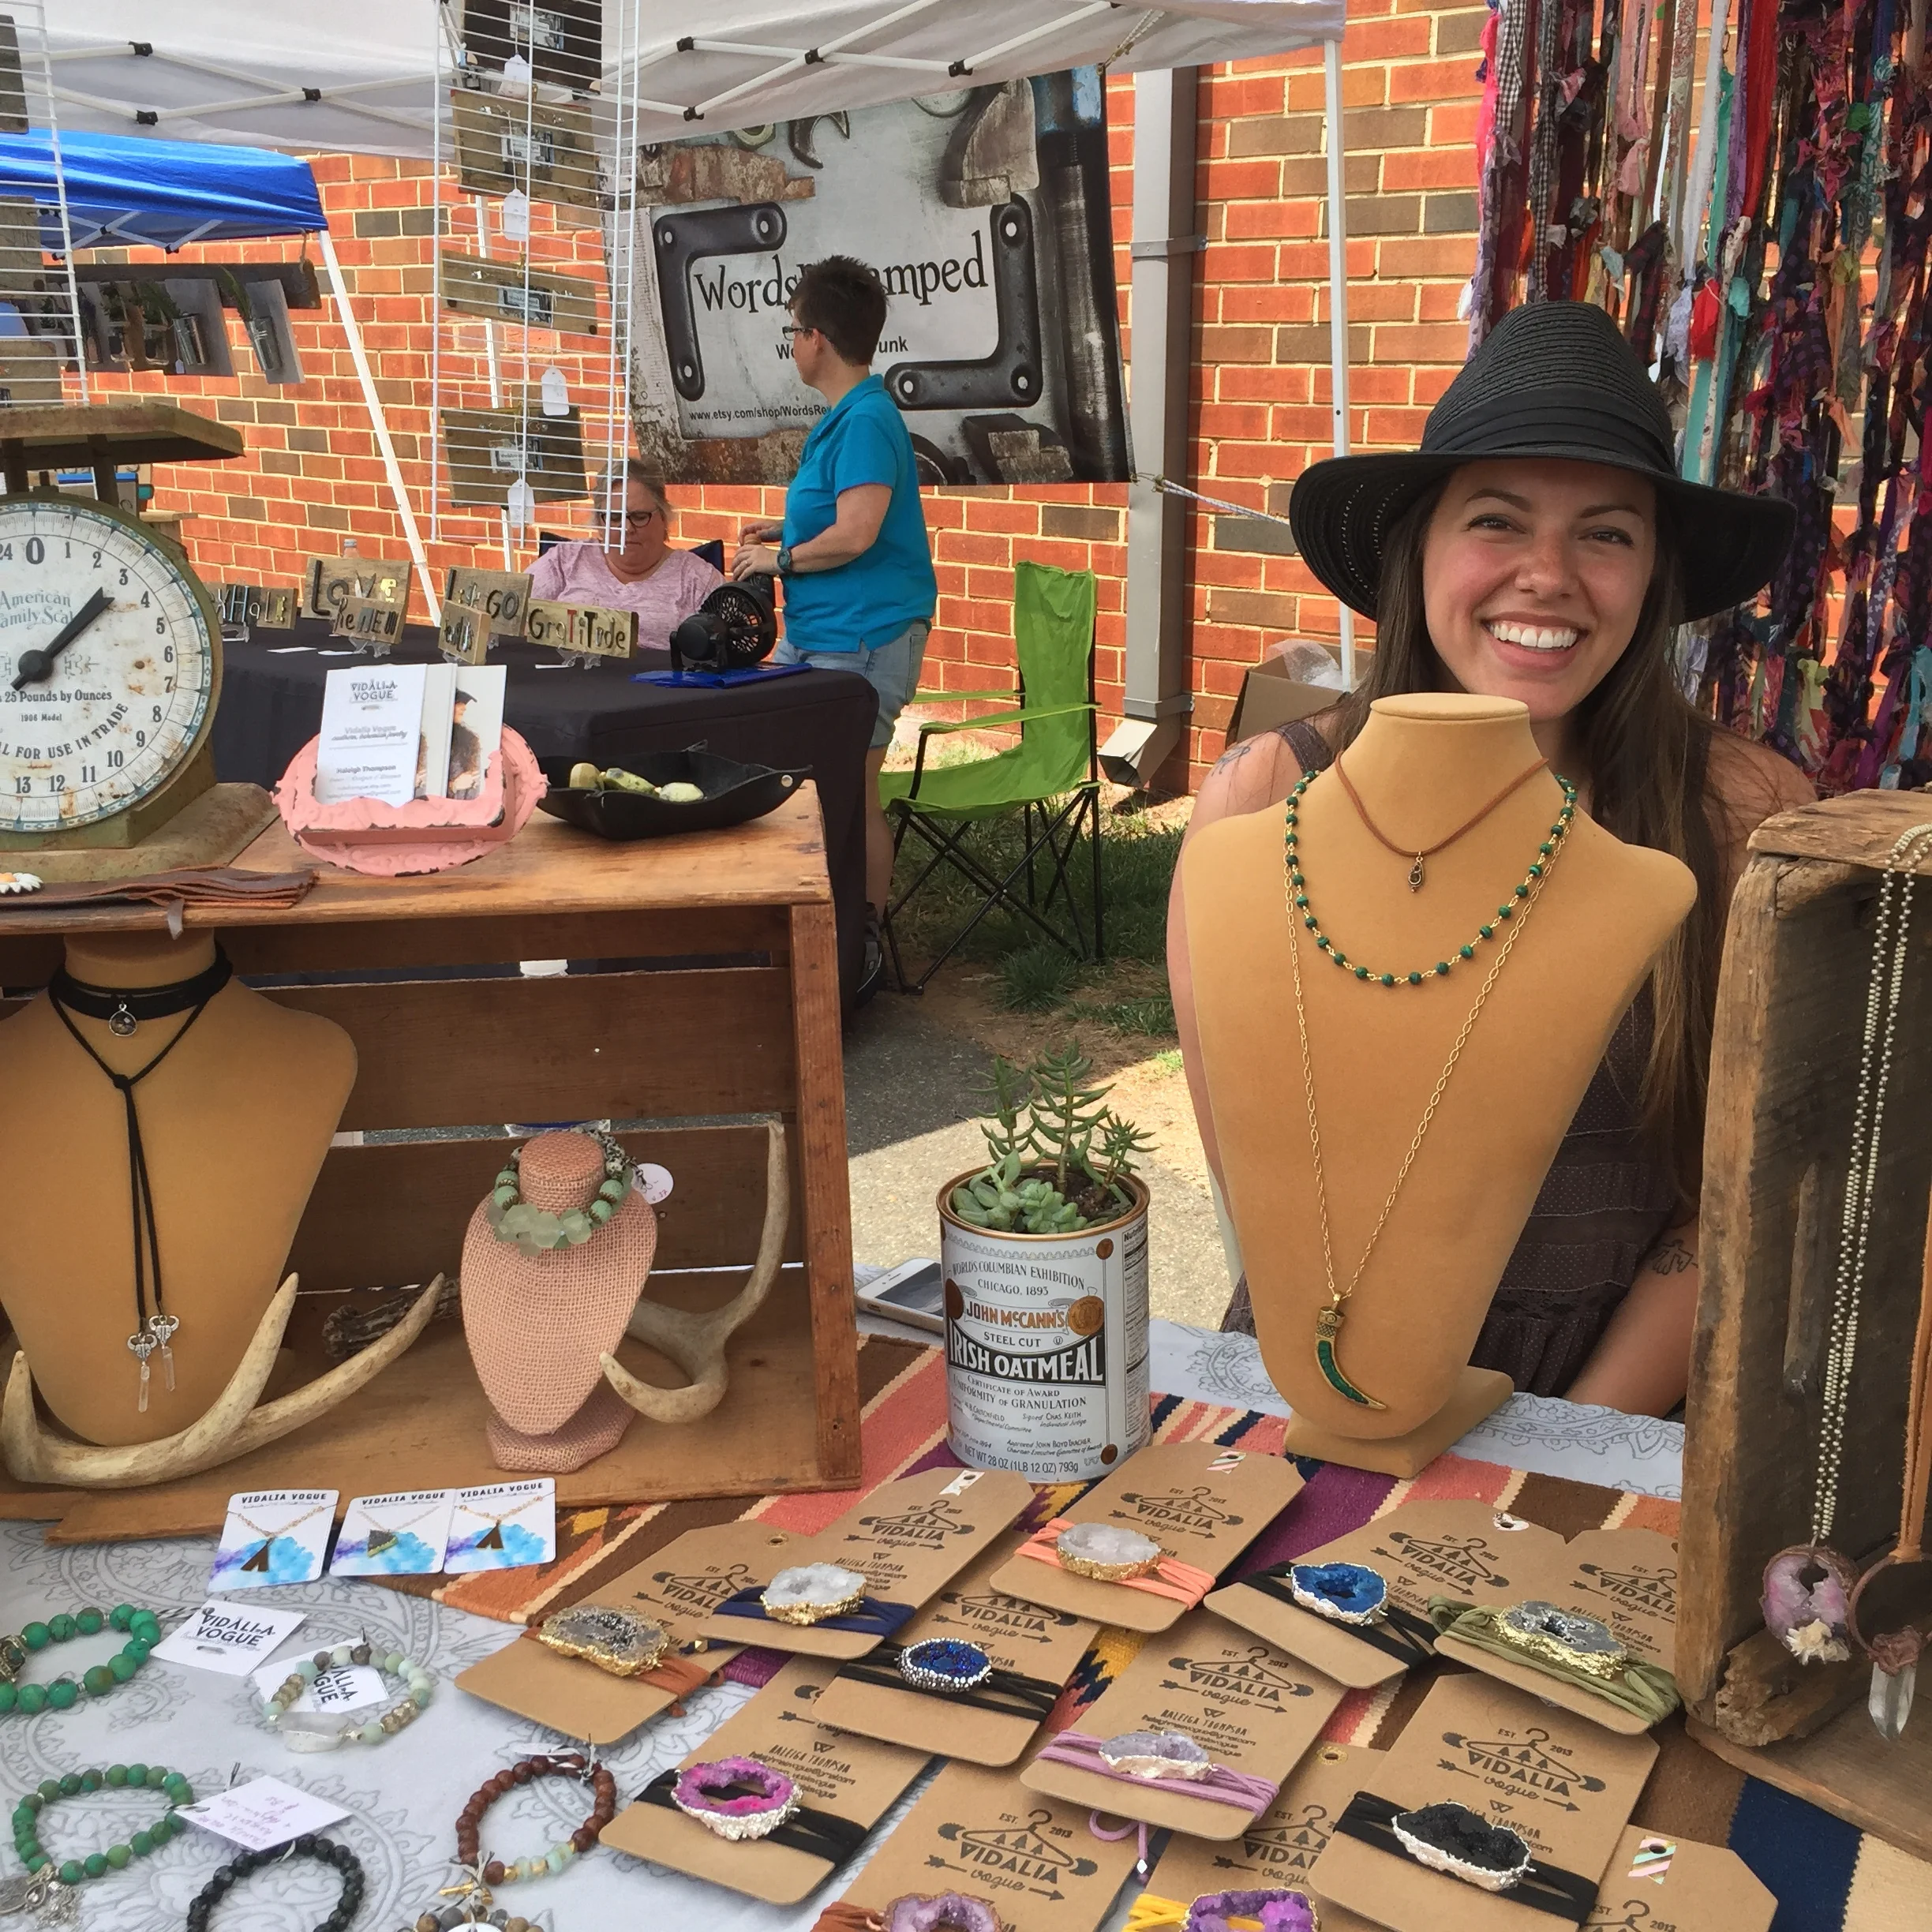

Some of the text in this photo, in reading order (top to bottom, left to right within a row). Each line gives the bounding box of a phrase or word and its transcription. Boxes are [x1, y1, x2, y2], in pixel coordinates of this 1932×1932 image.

[26, 537, 45, 564] 0
[66, 542, 71, 558] 1
[92, 552, 102, 568] 2
[119, 568, 128, 586] 3
[0, 590, 71, 610] American
[140, 591, 150, 608] 4
[0, 607, 39, 630] amily
[156, 617, 165, 634] 5
[164, 646, 174, 663] 6
[164, 676, 174, 693] 7
[5, 691, 17, 702] 25
[20, 690, 58, 702] Pounds
[61, 690, 71, 703] by
[74, 689, 112, 701] Ounces
[354, 690, 393, 701] VOGUE
[153, 706, 162, 722] 8
[15, 746, 40, 759] FOR
[48, 743, 73, 758] USE
[75, 736, 92, 750] IN
[91, 703, 129, 739] TRADE
[136, 731, 145, 747] 9
[107, 750, 124, 767] 10
[50, 774, 66, 792] 12
[82, 766, 96, 782] 11
[16, 776, 32, 793] 13
[979, 1261, 1027, 1276] COLUMBIAN
[1031, 1266, 1084, 1290] EXHIBITION
[1026, 1286, 1049, 1296] 1893
[967, 1301, 998, 1324] JOHN
[984, 1331, 1041, 1347] STEEL CUT
[948, 1317, 1103, 1381] IRISH OATMEAL
[953, 1374, 996, 1404] UNIFORMITY
[1011, 1396, 1087, 1410] GRANULATION
[968, 1375, 1011, 1395] CERTIFICATE
[1026, 1387, 1061, 1397] AWARD
[964, 1443, 975, 1458] NET
[976, 1451, 987, 1463] WT
[987, 1455, 997, 1466] 28
[1031, 1462, 1040, 1473] 12
[242, 1493, 286, 1503] VIDALIA
[361, 1496, 406, 1506] VIDALIA
[410, 1492, 446, 1500] VOGUE
[460, 1487, 504, 1498] VIDALIA
[509, 1482, 543, 1492] VOGUE
[1137, 1503, 1213, 1530] VIDALIA
[871, 1524, 945, 1541] VIDALIA
[1401, 1544, 1478, 1586] VIDALIA
[662, 1583, 717, 1609] VIDAL
[1600, 1577, 1676, 1616] VIDALI
[1609, 1596, 1658, 1617] vogue
[961, 1604, 1046, 1632] VIDALIA
[197, 1626, 264, 1646] VOGUE
[972, 1623, 1019, 1638] vogue
[1267, 1657, 1289, 1669] 2013
[1190, 1670, 1280, 1702] VIDALIA
[1200, 1688, 1252, 1706] vogue
[1549, 1744, 1573, 1757] 2013
[1468, 1750, 1570, 1797] VIDALIA
[1484, 1776, 1539, 1799] vogue
[1048, 1826, 1073, 1839] 2013
[960, 1841, 1058, 1884] VIDALIA
[1243, 1840, 1318, 1870] VIDA
[970, 1868, 1026, 1891] vogue
[1261, 1866, 1310, 1887] vogu
